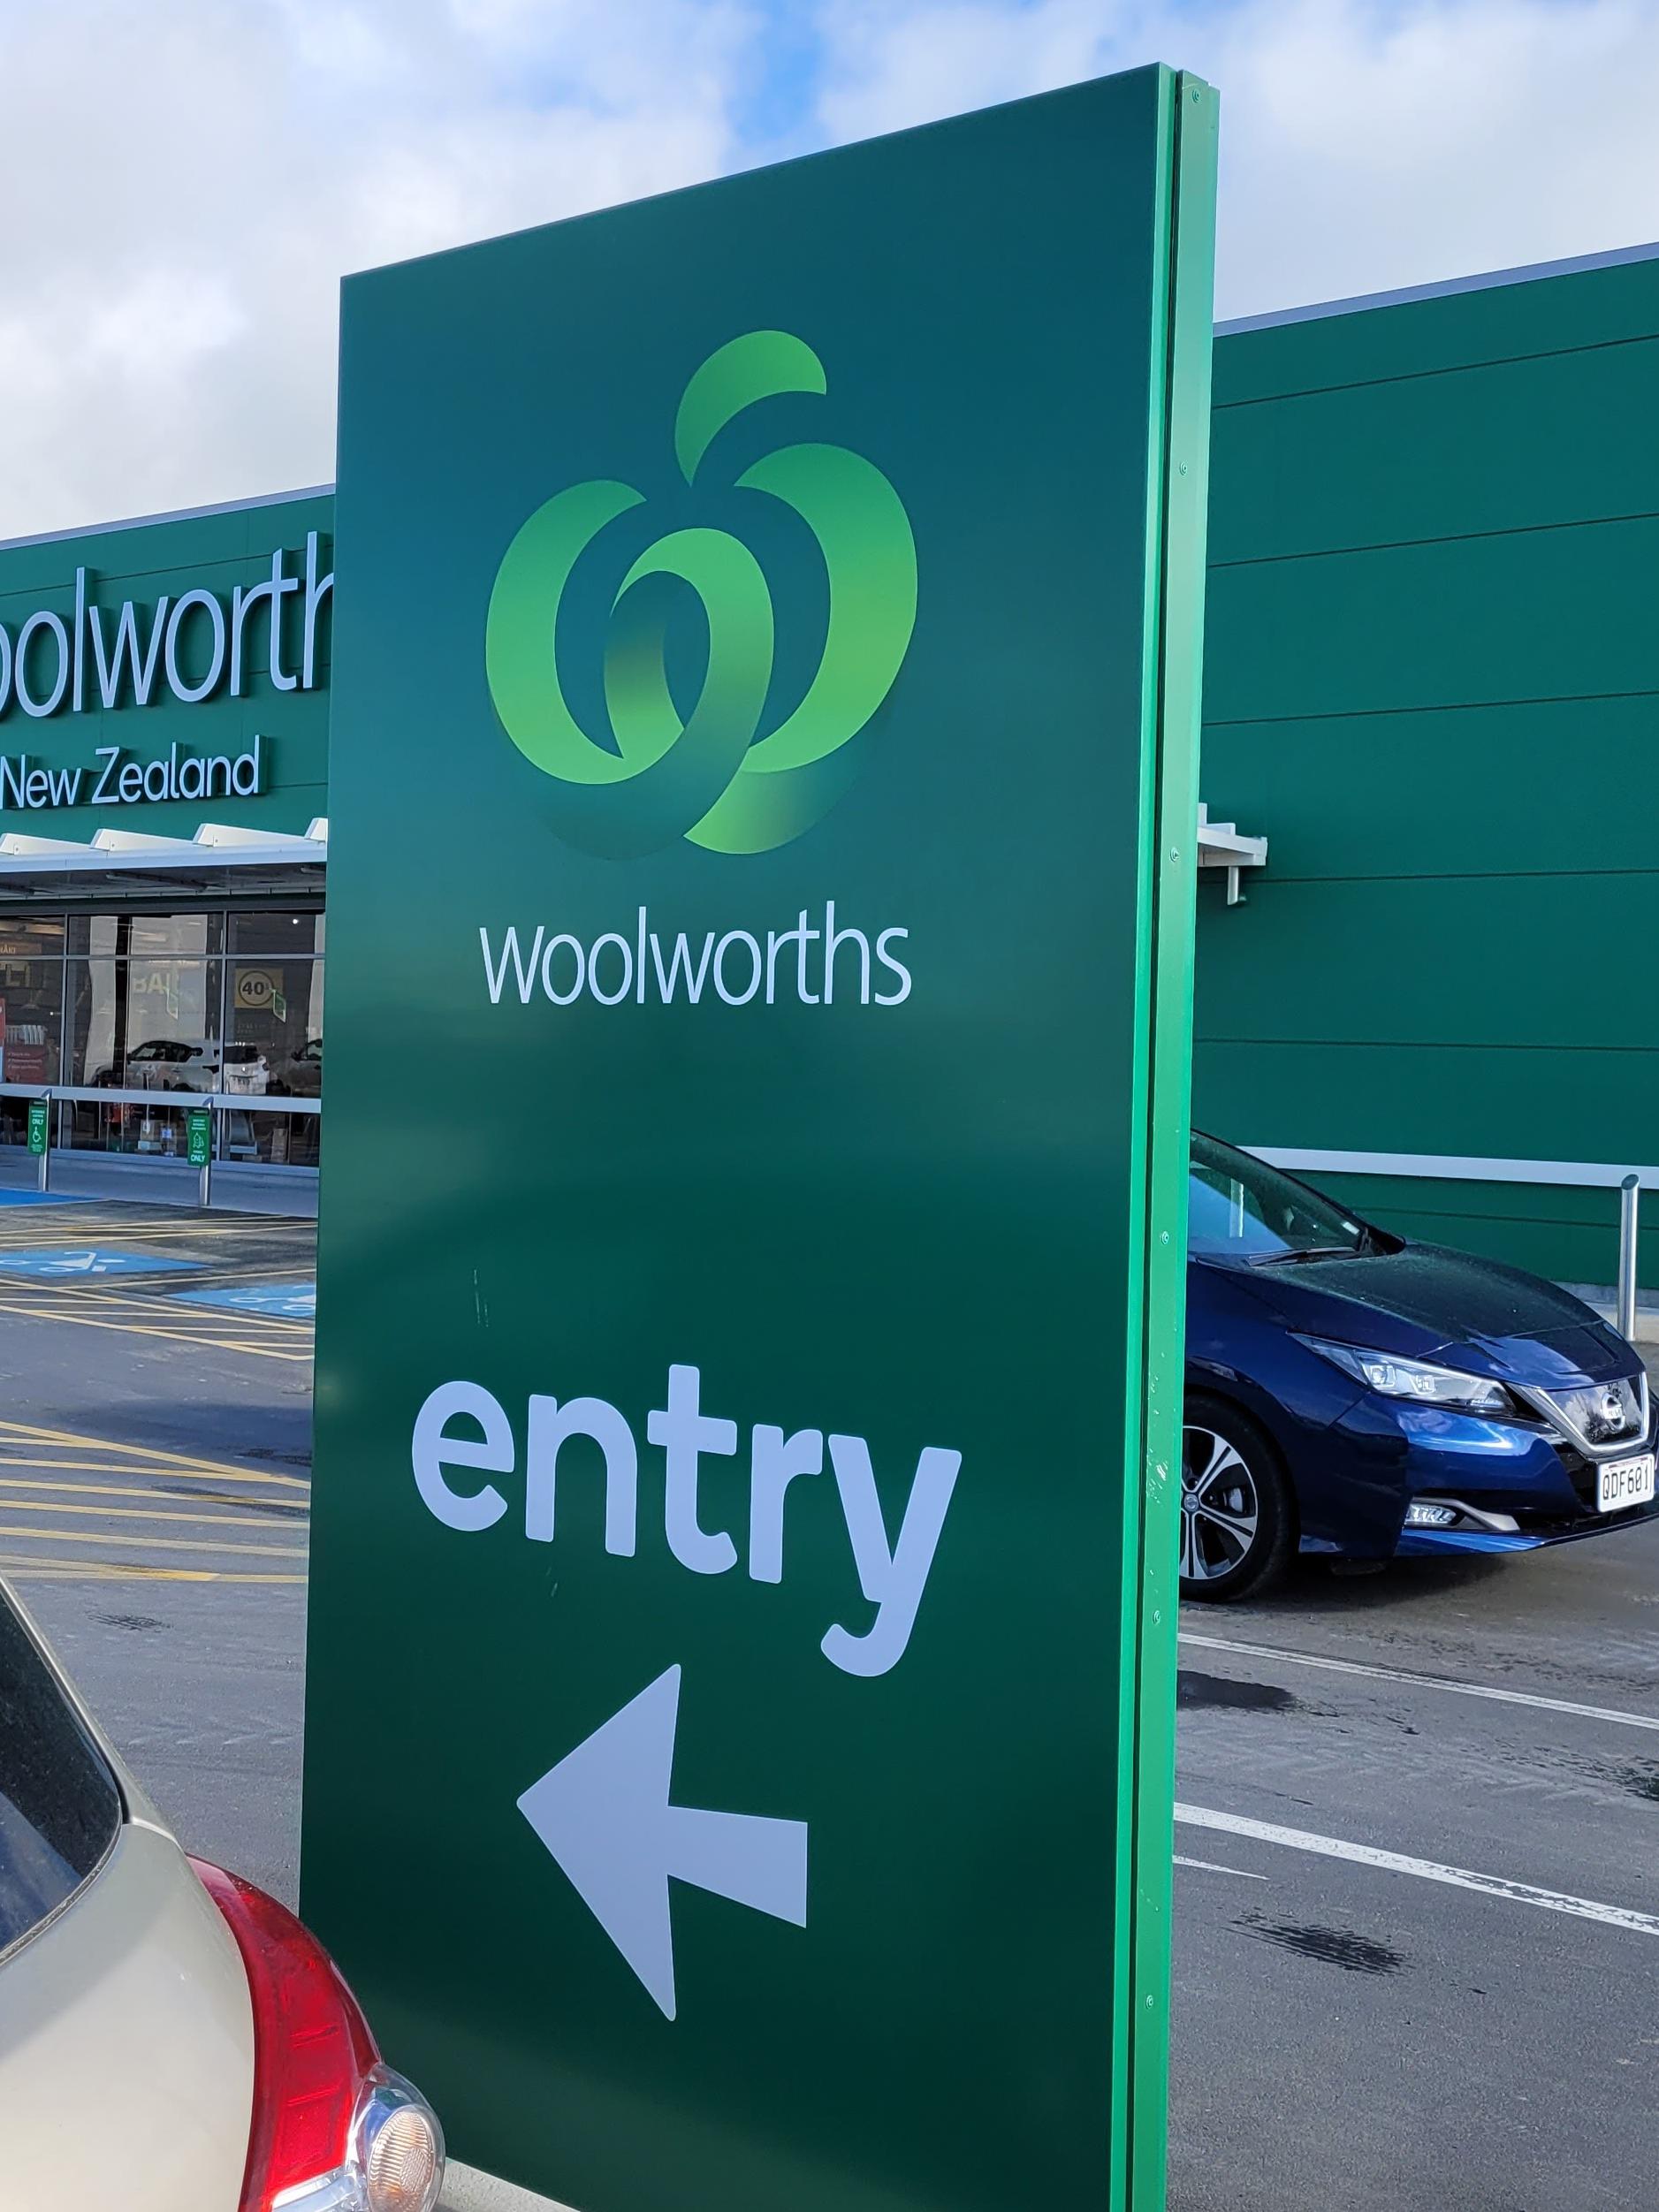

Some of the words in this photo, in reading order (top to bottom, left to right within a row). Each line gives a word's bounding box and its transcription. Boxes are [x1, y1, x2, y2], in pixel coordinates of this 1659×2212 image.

[0, 530, 334, 717] olworth
[0, 754, 82, 810] New
[91, 734, 260, 805] Zealand
[479, 900, 912, 1006] Woolworths
[412, 1364, 963, 1676] entry
[1602, 1465, 1648, 1501] QDF601
